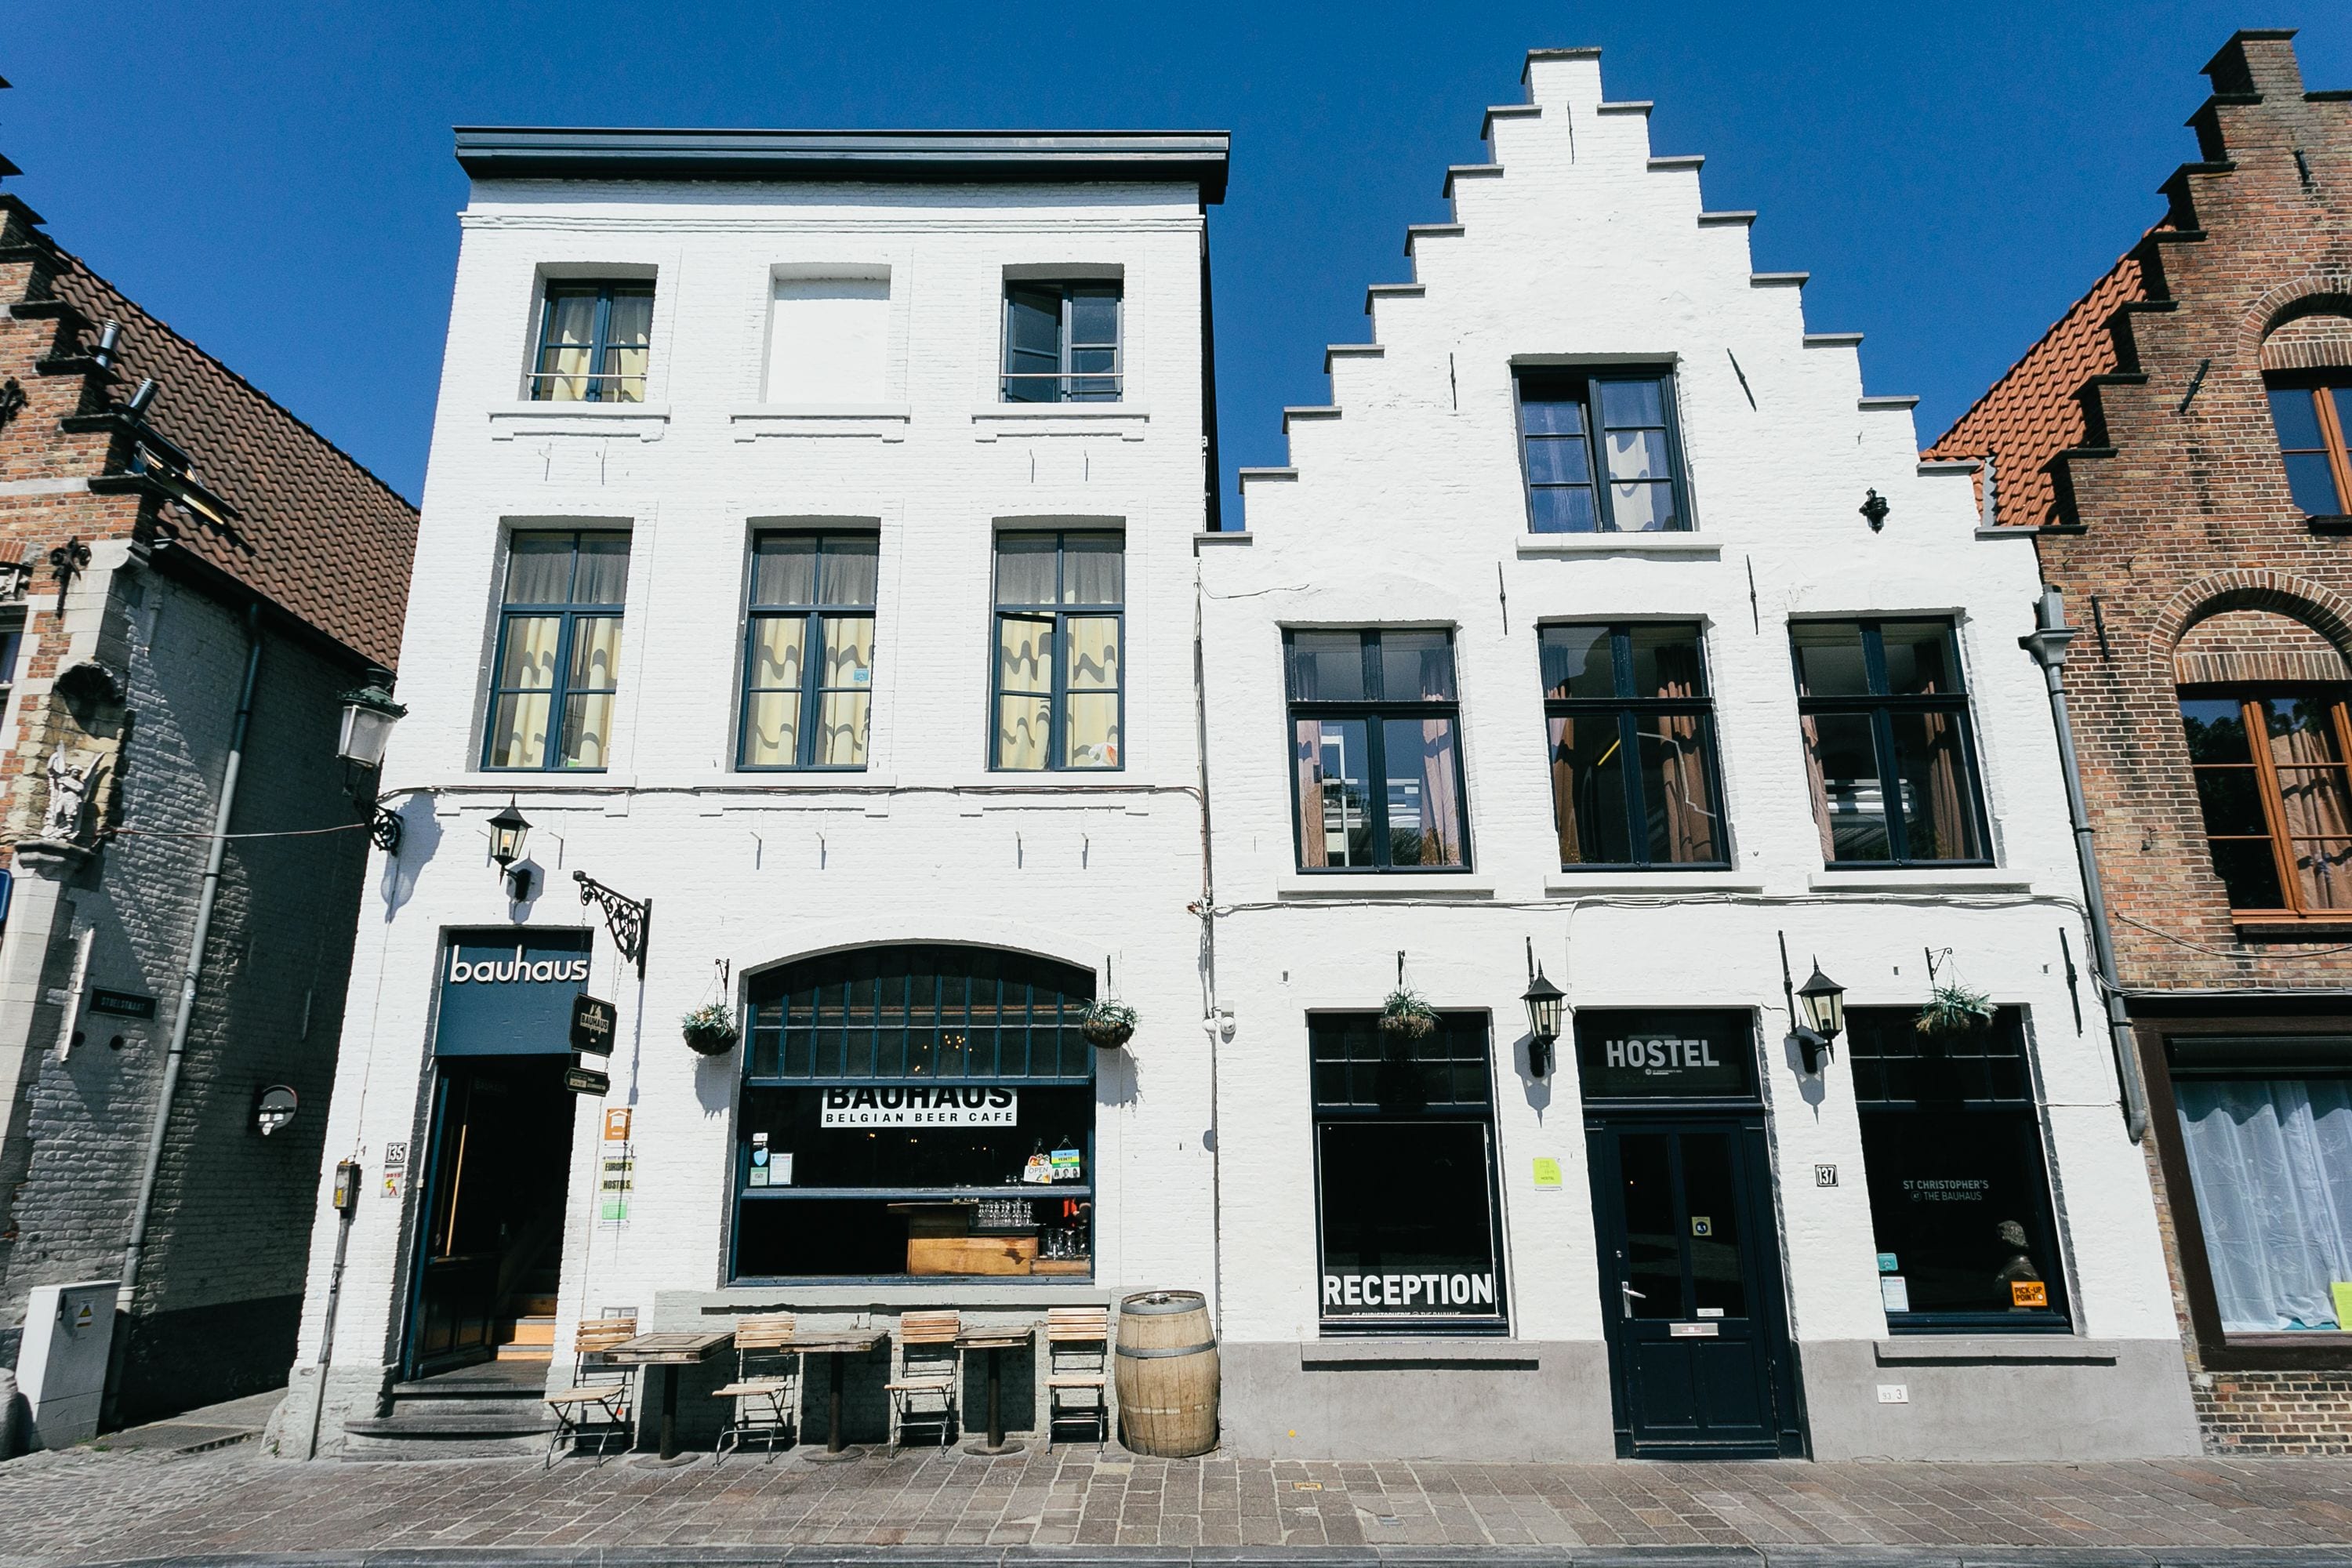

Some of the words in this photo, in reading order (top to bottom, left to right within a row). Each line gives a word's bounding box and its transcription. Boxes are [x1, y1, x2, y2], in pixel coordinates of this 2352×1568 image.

[449, 944, 588, 982] bauhaus
[581, 1014, 608, 1030] BAUHAUS
[1606, 1040, 1720, 1068] HOSTEL
[826, 1087, 1013, 1109] BAUHAUS
[826, 1112, 904, 1123] BELGIAN
[914, 1112, 958, 1122] BEER
[968, 1112, 1013, 1122] CAFE
[387, 1145, 405, 1161] 135
[1817, 1167, 1835, 1184] 137
[1903, 1180, 1914, 1189] ST
[1917, 1180, 1990, 1189] CHRISTOPHER'S
[1924, 1192, 1940, 1201] THE
[1942, 1192, 1983, 1201] BAUHAUS
[1323, 1273, 1494, 1305] RECEPTION
